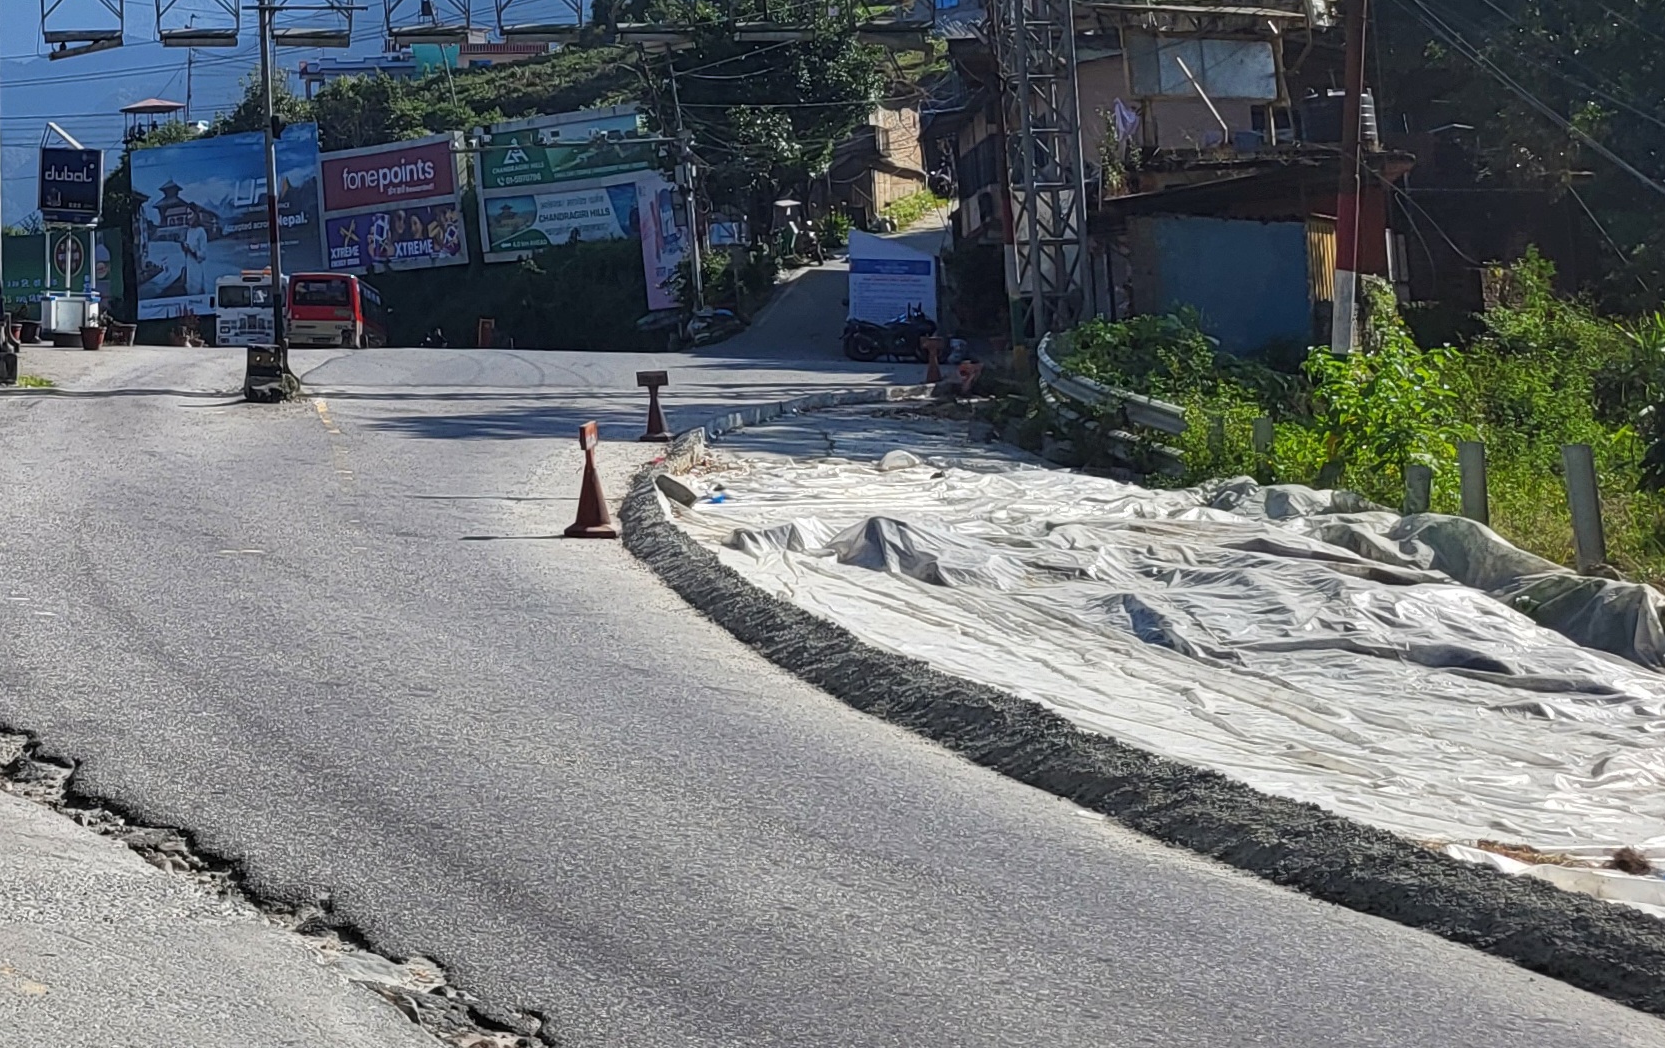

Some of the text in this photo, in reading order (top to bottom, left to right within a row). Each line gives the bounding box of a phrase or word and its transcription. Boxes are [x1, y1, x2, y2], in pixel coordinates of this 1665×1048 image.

[342, 158, 434, 192] fonepoints
[538, 207, 611, 223] CHANDRAGIRI HILLS
[331, 245, 360, 259] XTREME
[394, 238, 434, 257] XTREME
